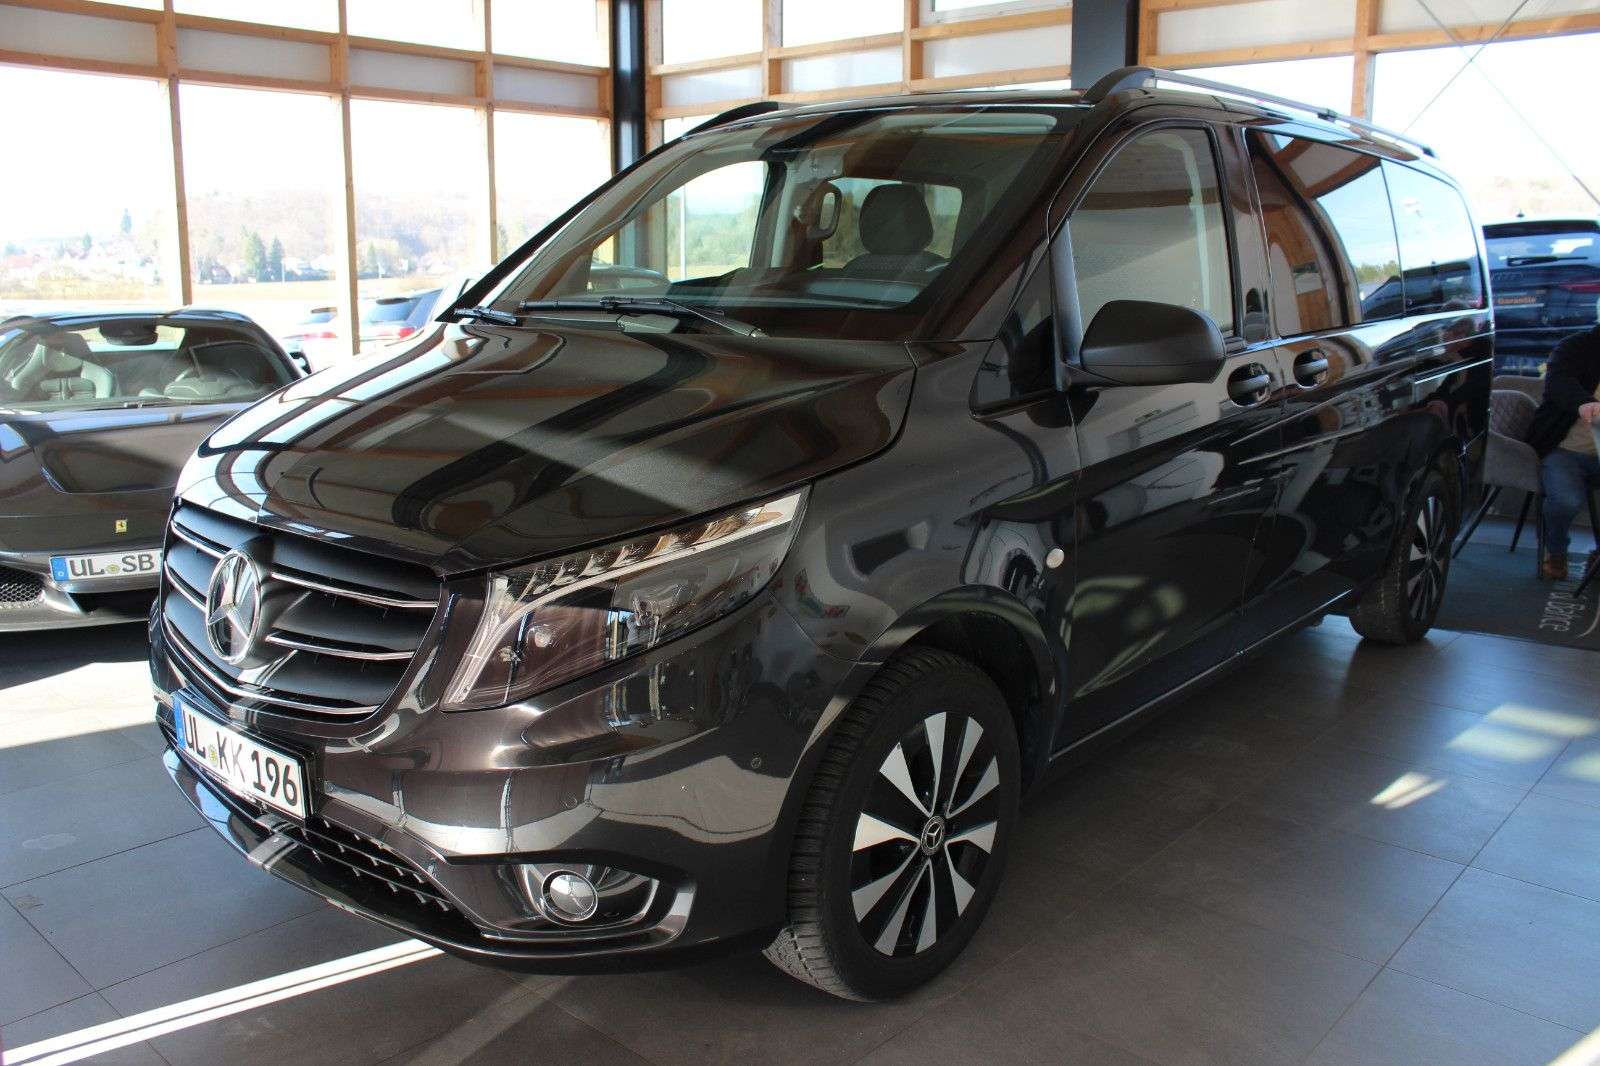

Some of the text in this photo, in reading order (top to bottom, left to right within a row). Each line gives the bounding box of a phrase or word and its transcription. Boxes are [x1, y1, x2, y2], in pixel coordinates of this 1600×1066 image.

[69, 554, 155, 577] UL SB
[183, 710, 298, 807] UL KK 196
